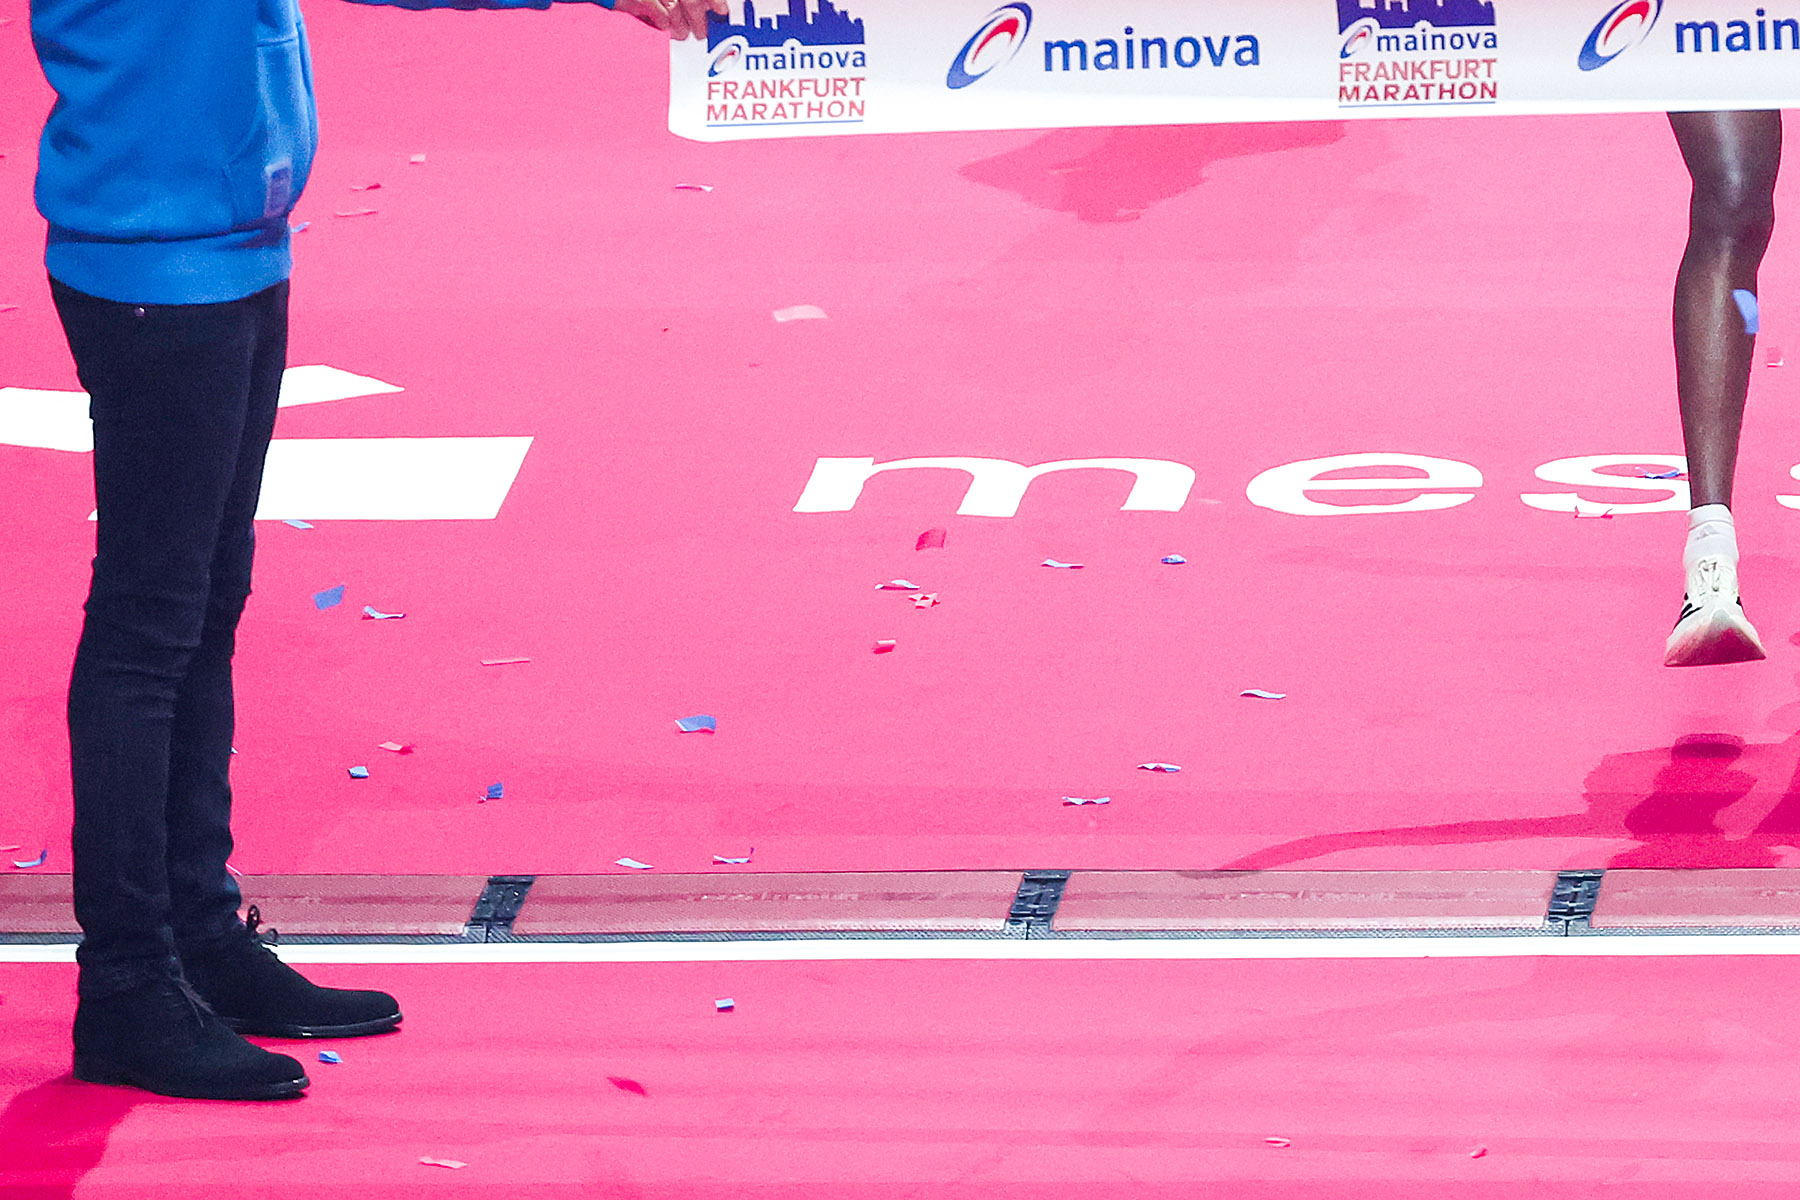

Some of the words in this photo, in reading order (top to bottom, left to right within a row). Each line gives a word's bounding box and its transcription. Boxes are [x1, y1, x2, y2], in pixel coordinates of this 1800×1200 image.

[1043, 26, 1260, 72] mainova
[1376, 25, 1498, 52] mainova
[745, 41, 866, 71] mainova
[1339, 58, 1497, 83] FRANKFURT
[708, 77, 865, 101] FRANKFURT
[1339, 81, 1497, 102] MARATHON
[707, 100, 865, 121] MARATHON
